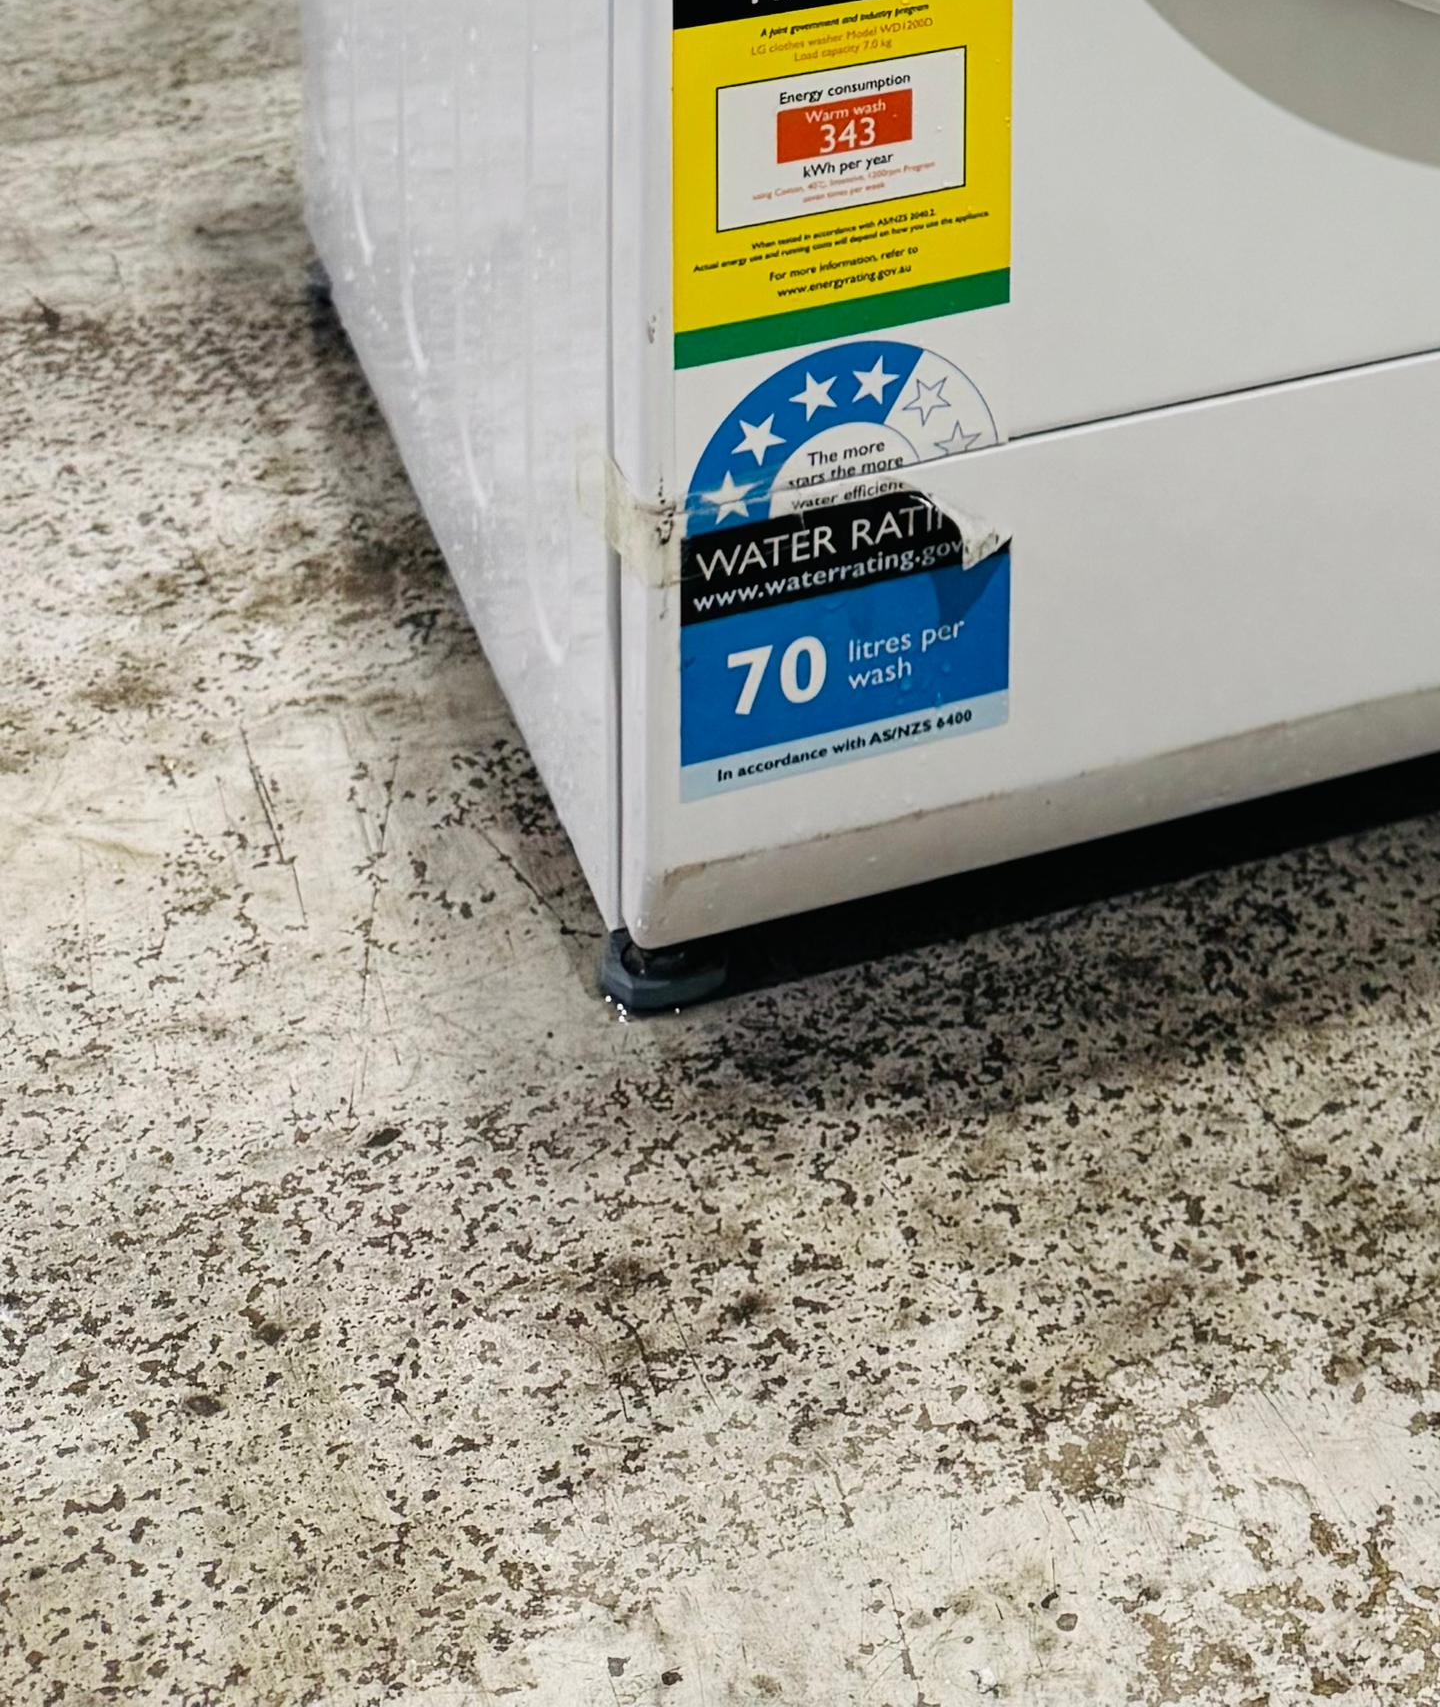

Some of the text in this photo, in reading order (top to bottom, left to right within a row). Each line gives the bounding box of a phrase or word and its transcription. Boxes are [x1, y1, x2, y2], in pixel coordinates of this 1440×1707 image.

[751, 45, 766, 56] LG
[846, 28, 877, 40] Model
[761, 28, 767, 37] A
[794, 51, 818, 62] Load
[880, 39, 892, 49] kg
[779, 74, 911, 105] Energy consumption
[805, 99, 886, 124] Warm wash
[819, 117, 876, 154] 343
[803, 153, 894, 178] kWh per year
[769, 271, 786, 281] For
[790, 266, 816, 276] more
[881, 247, 905, 259] refer
[808, 441, 885, 466] The more
[788, 457, 903, 487] stars the more
[696, 504, 946, 582] WATER RATI
[726, 618, 964, 715] 70 litres per
[848, 660, 912, 690] wash
[717, 709, 972, 782] In accordance with AS/NZS 6400
